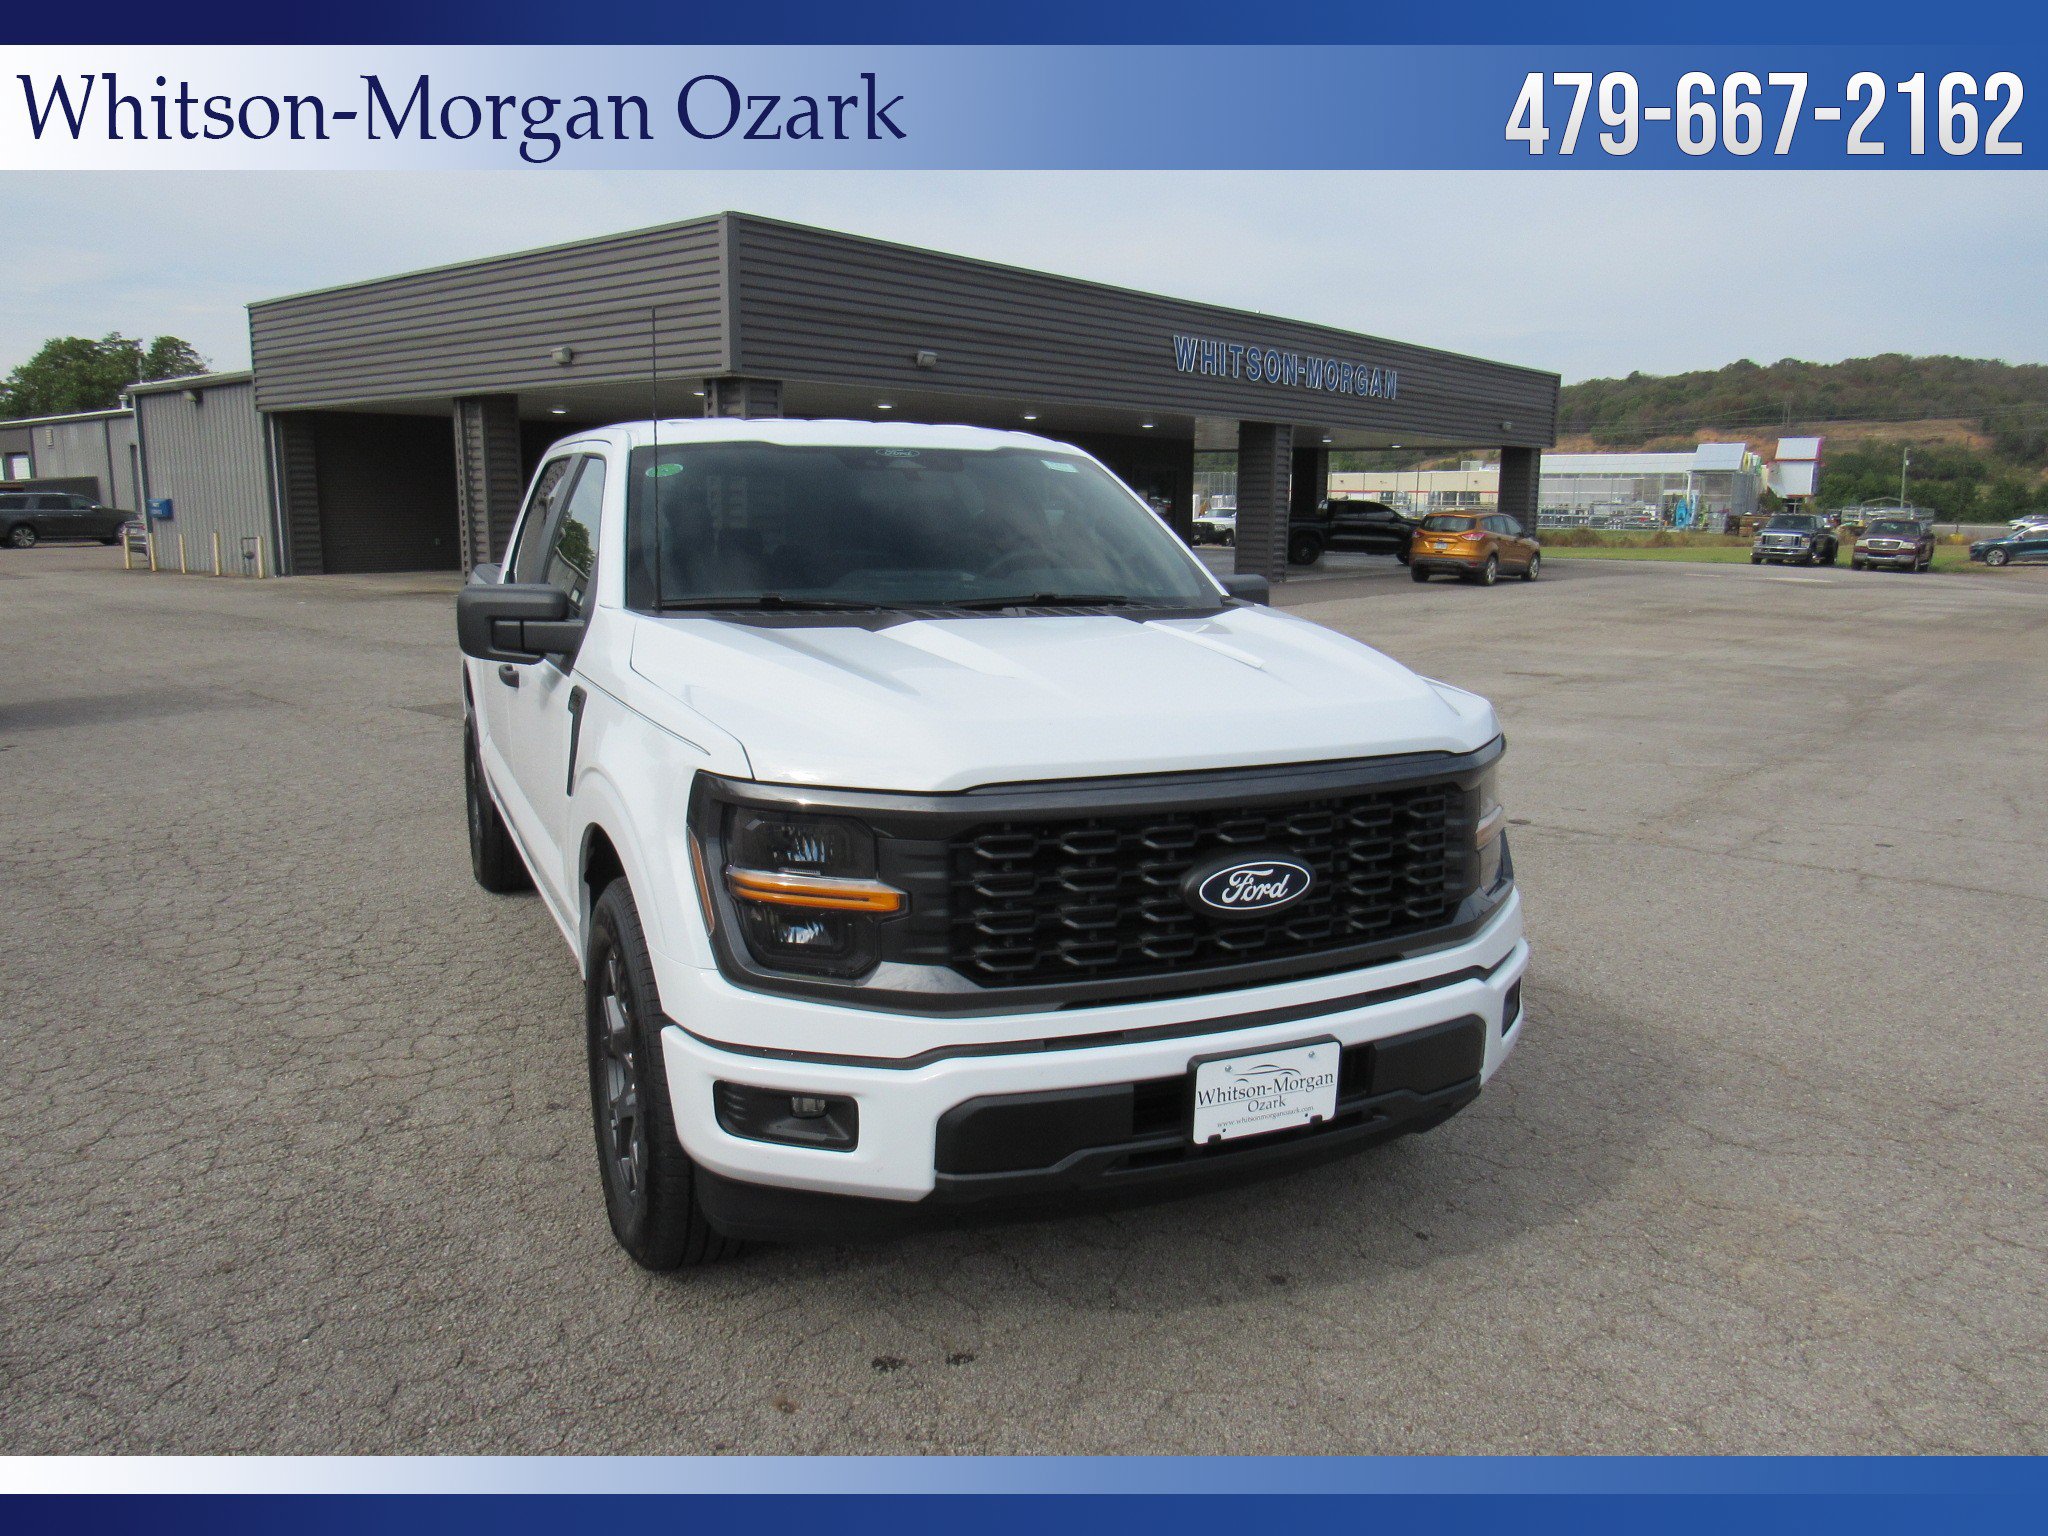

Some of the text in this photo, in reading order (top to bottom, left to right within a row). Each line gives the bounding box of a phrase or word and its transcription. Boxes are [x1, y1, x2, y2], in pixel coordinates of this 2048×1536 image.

[1173, 335, 1398, 400] WHITSON-MORGAN
[1222, 868, 1292, 903] Ford
[1197, 1073, 1334, 1106] Whitson-Morgan
[1247, 1095, 1286, 1113] Ozark
